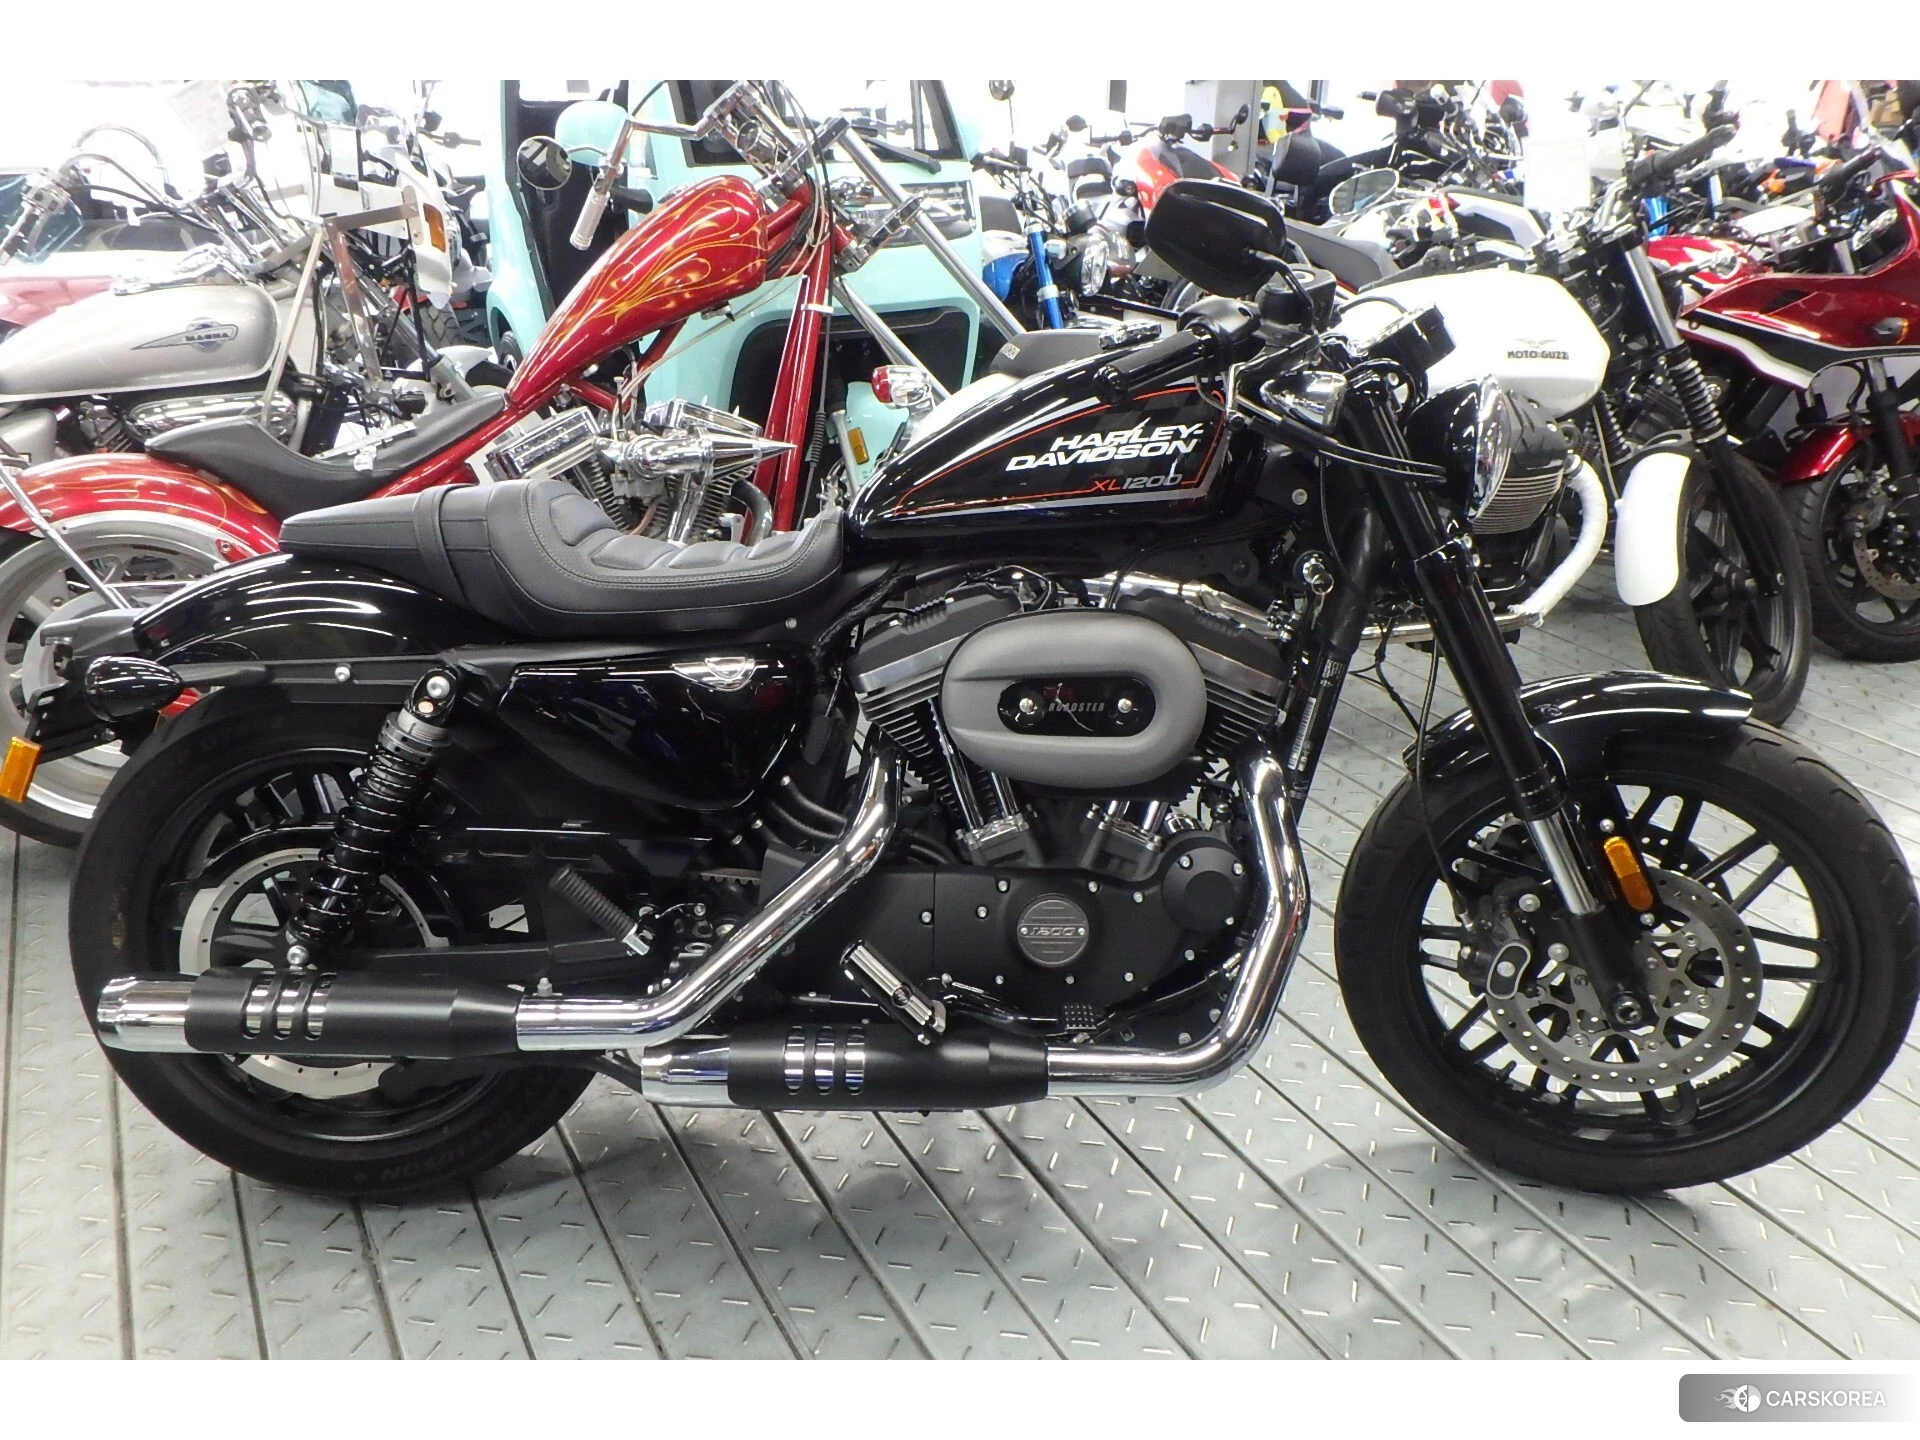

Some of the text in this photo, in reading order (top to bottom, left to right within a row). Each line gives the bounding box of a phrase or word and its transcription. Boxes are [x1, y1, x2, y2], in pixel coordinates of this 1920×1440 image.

[1507, 350, 1538, 359] MOTO
[1005, 438, 1199, 472] DAVIDSON
[1048, 702, 1106, 713] ROADSTER
